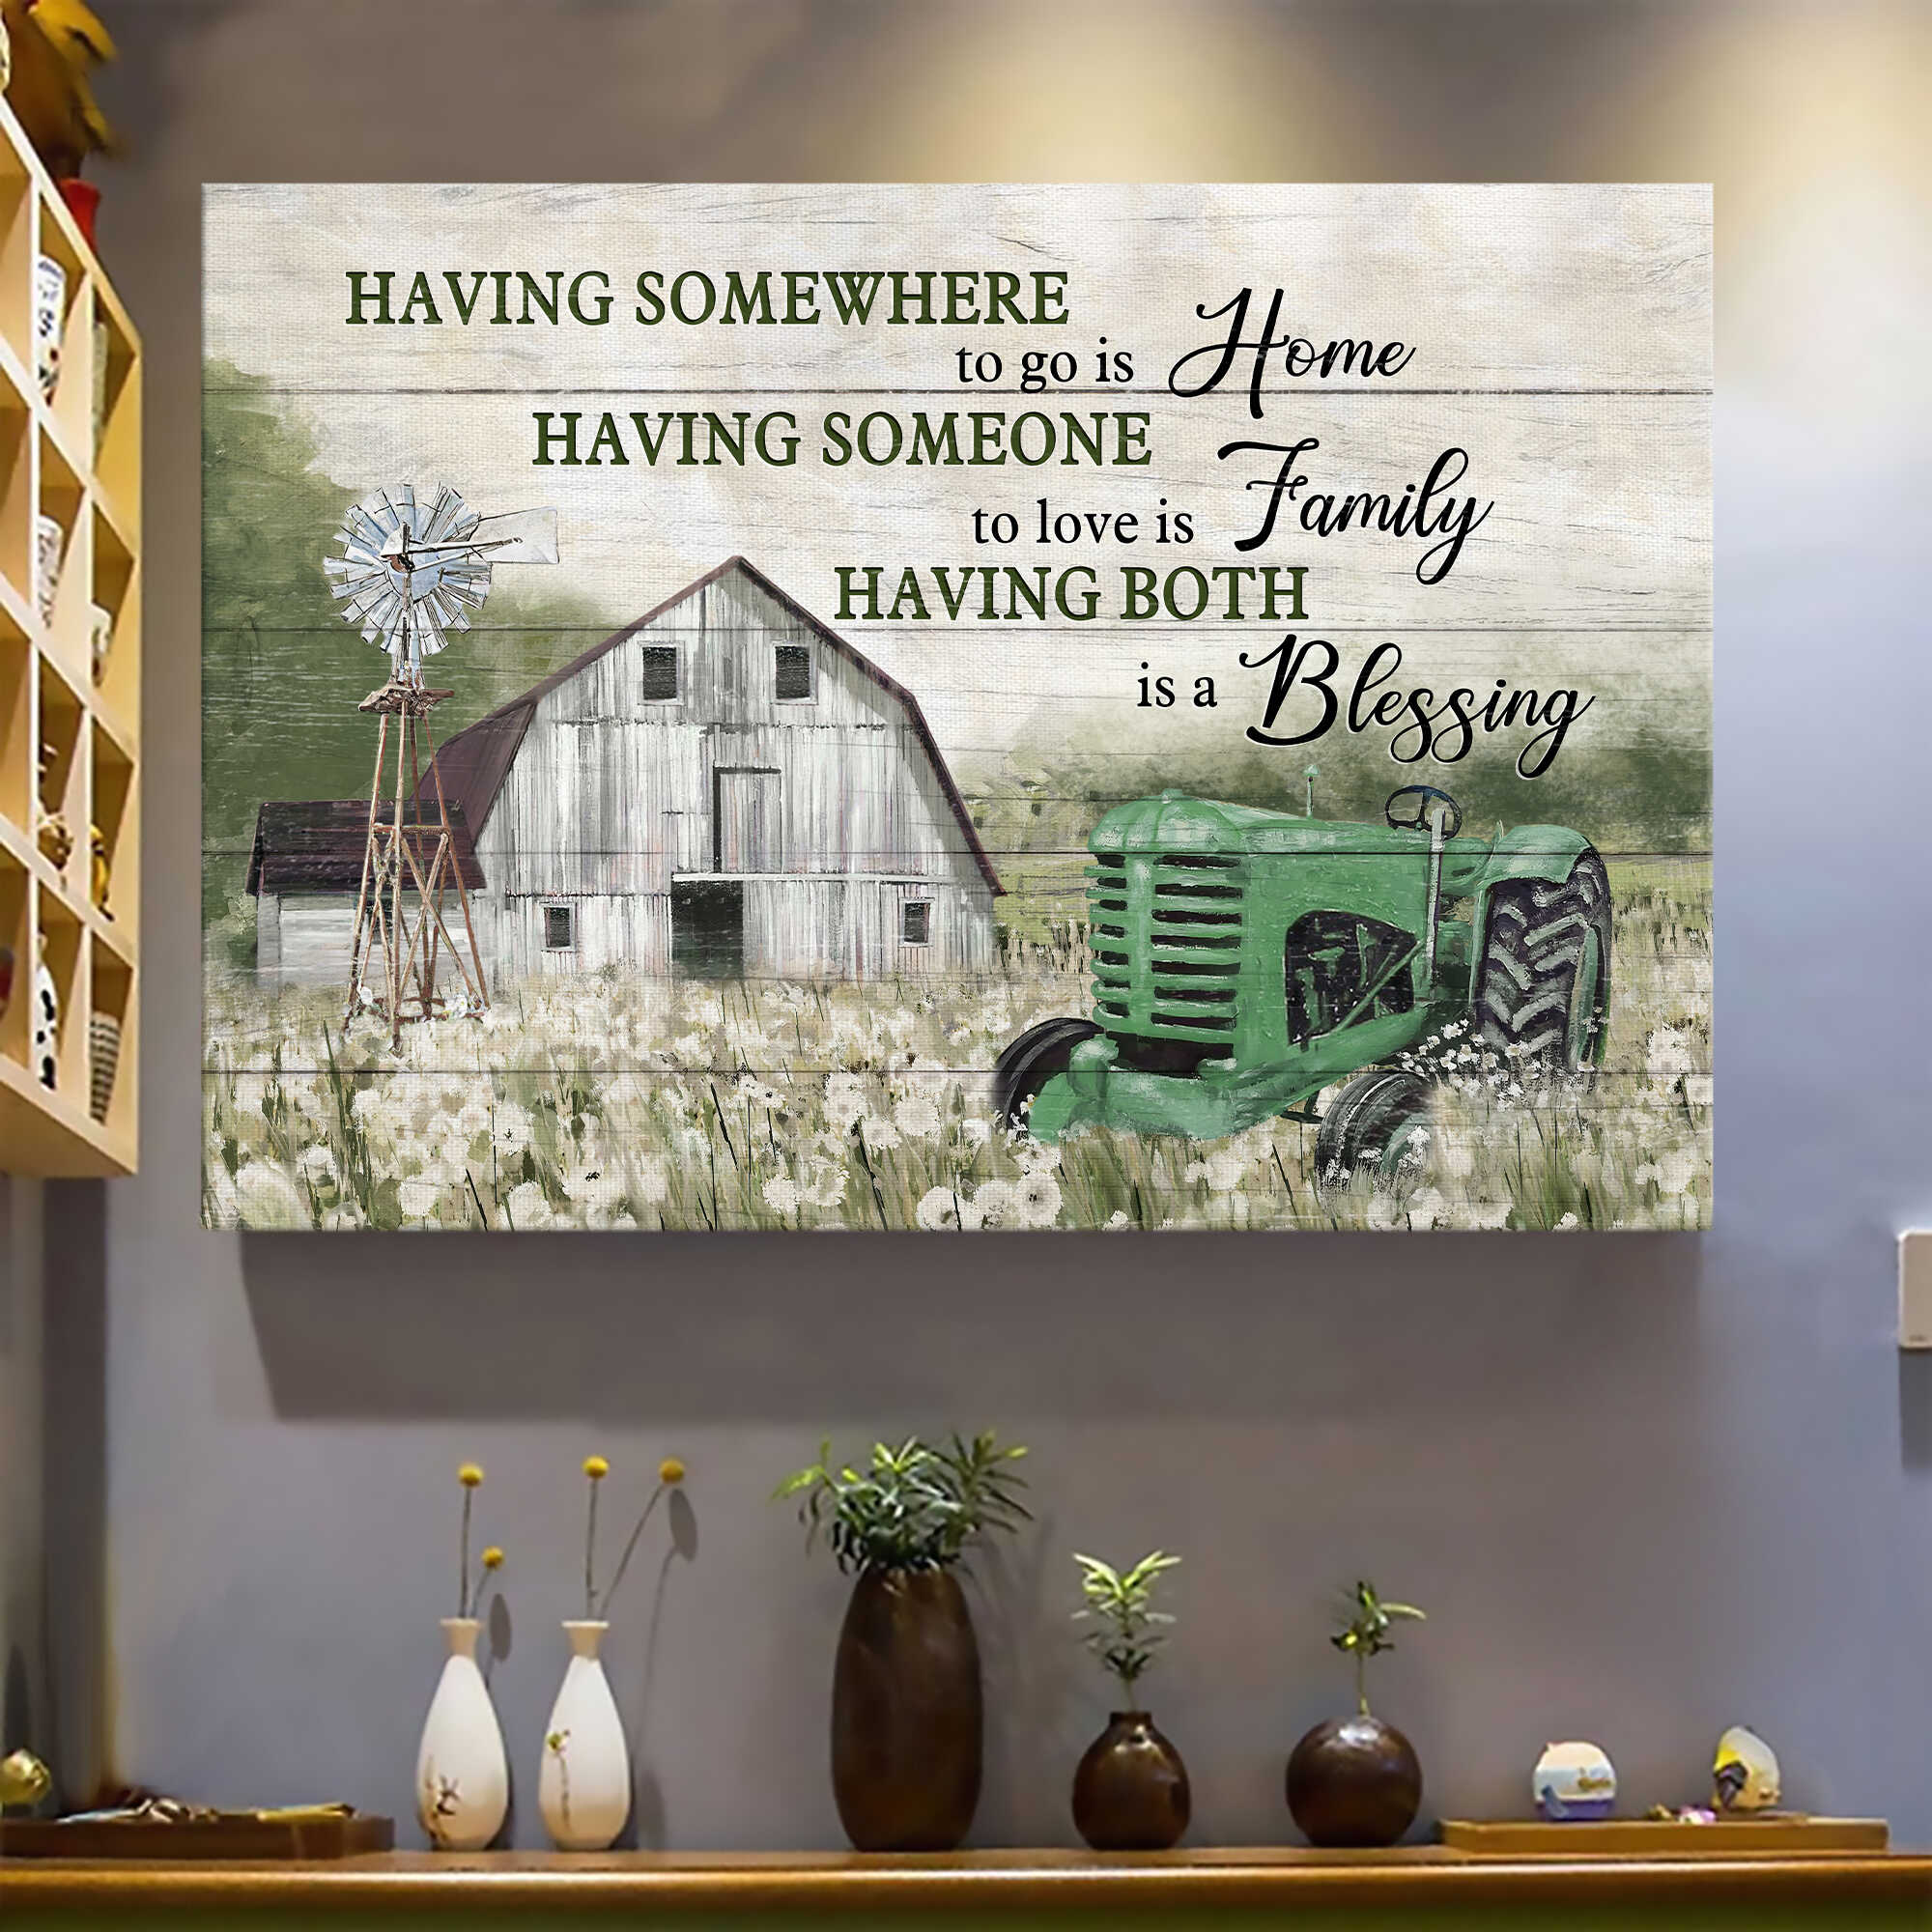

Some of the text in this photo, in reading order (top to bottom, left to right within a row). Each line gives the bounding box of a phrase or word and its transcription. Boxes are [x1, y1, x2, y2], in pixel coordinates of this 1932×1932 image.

[345, 270, 1070, 327] HAVING SOMEWHERE
[956, 287, 1417, 420] to go is Home
[531, 412, 1153, 467] HAVING SOMEONE
[973, 438, 1495, 585] to love is Family
[834, 566, 1310, 622] HAVING BOTH
[1136, 634, 1597, 780] is a Blessing
